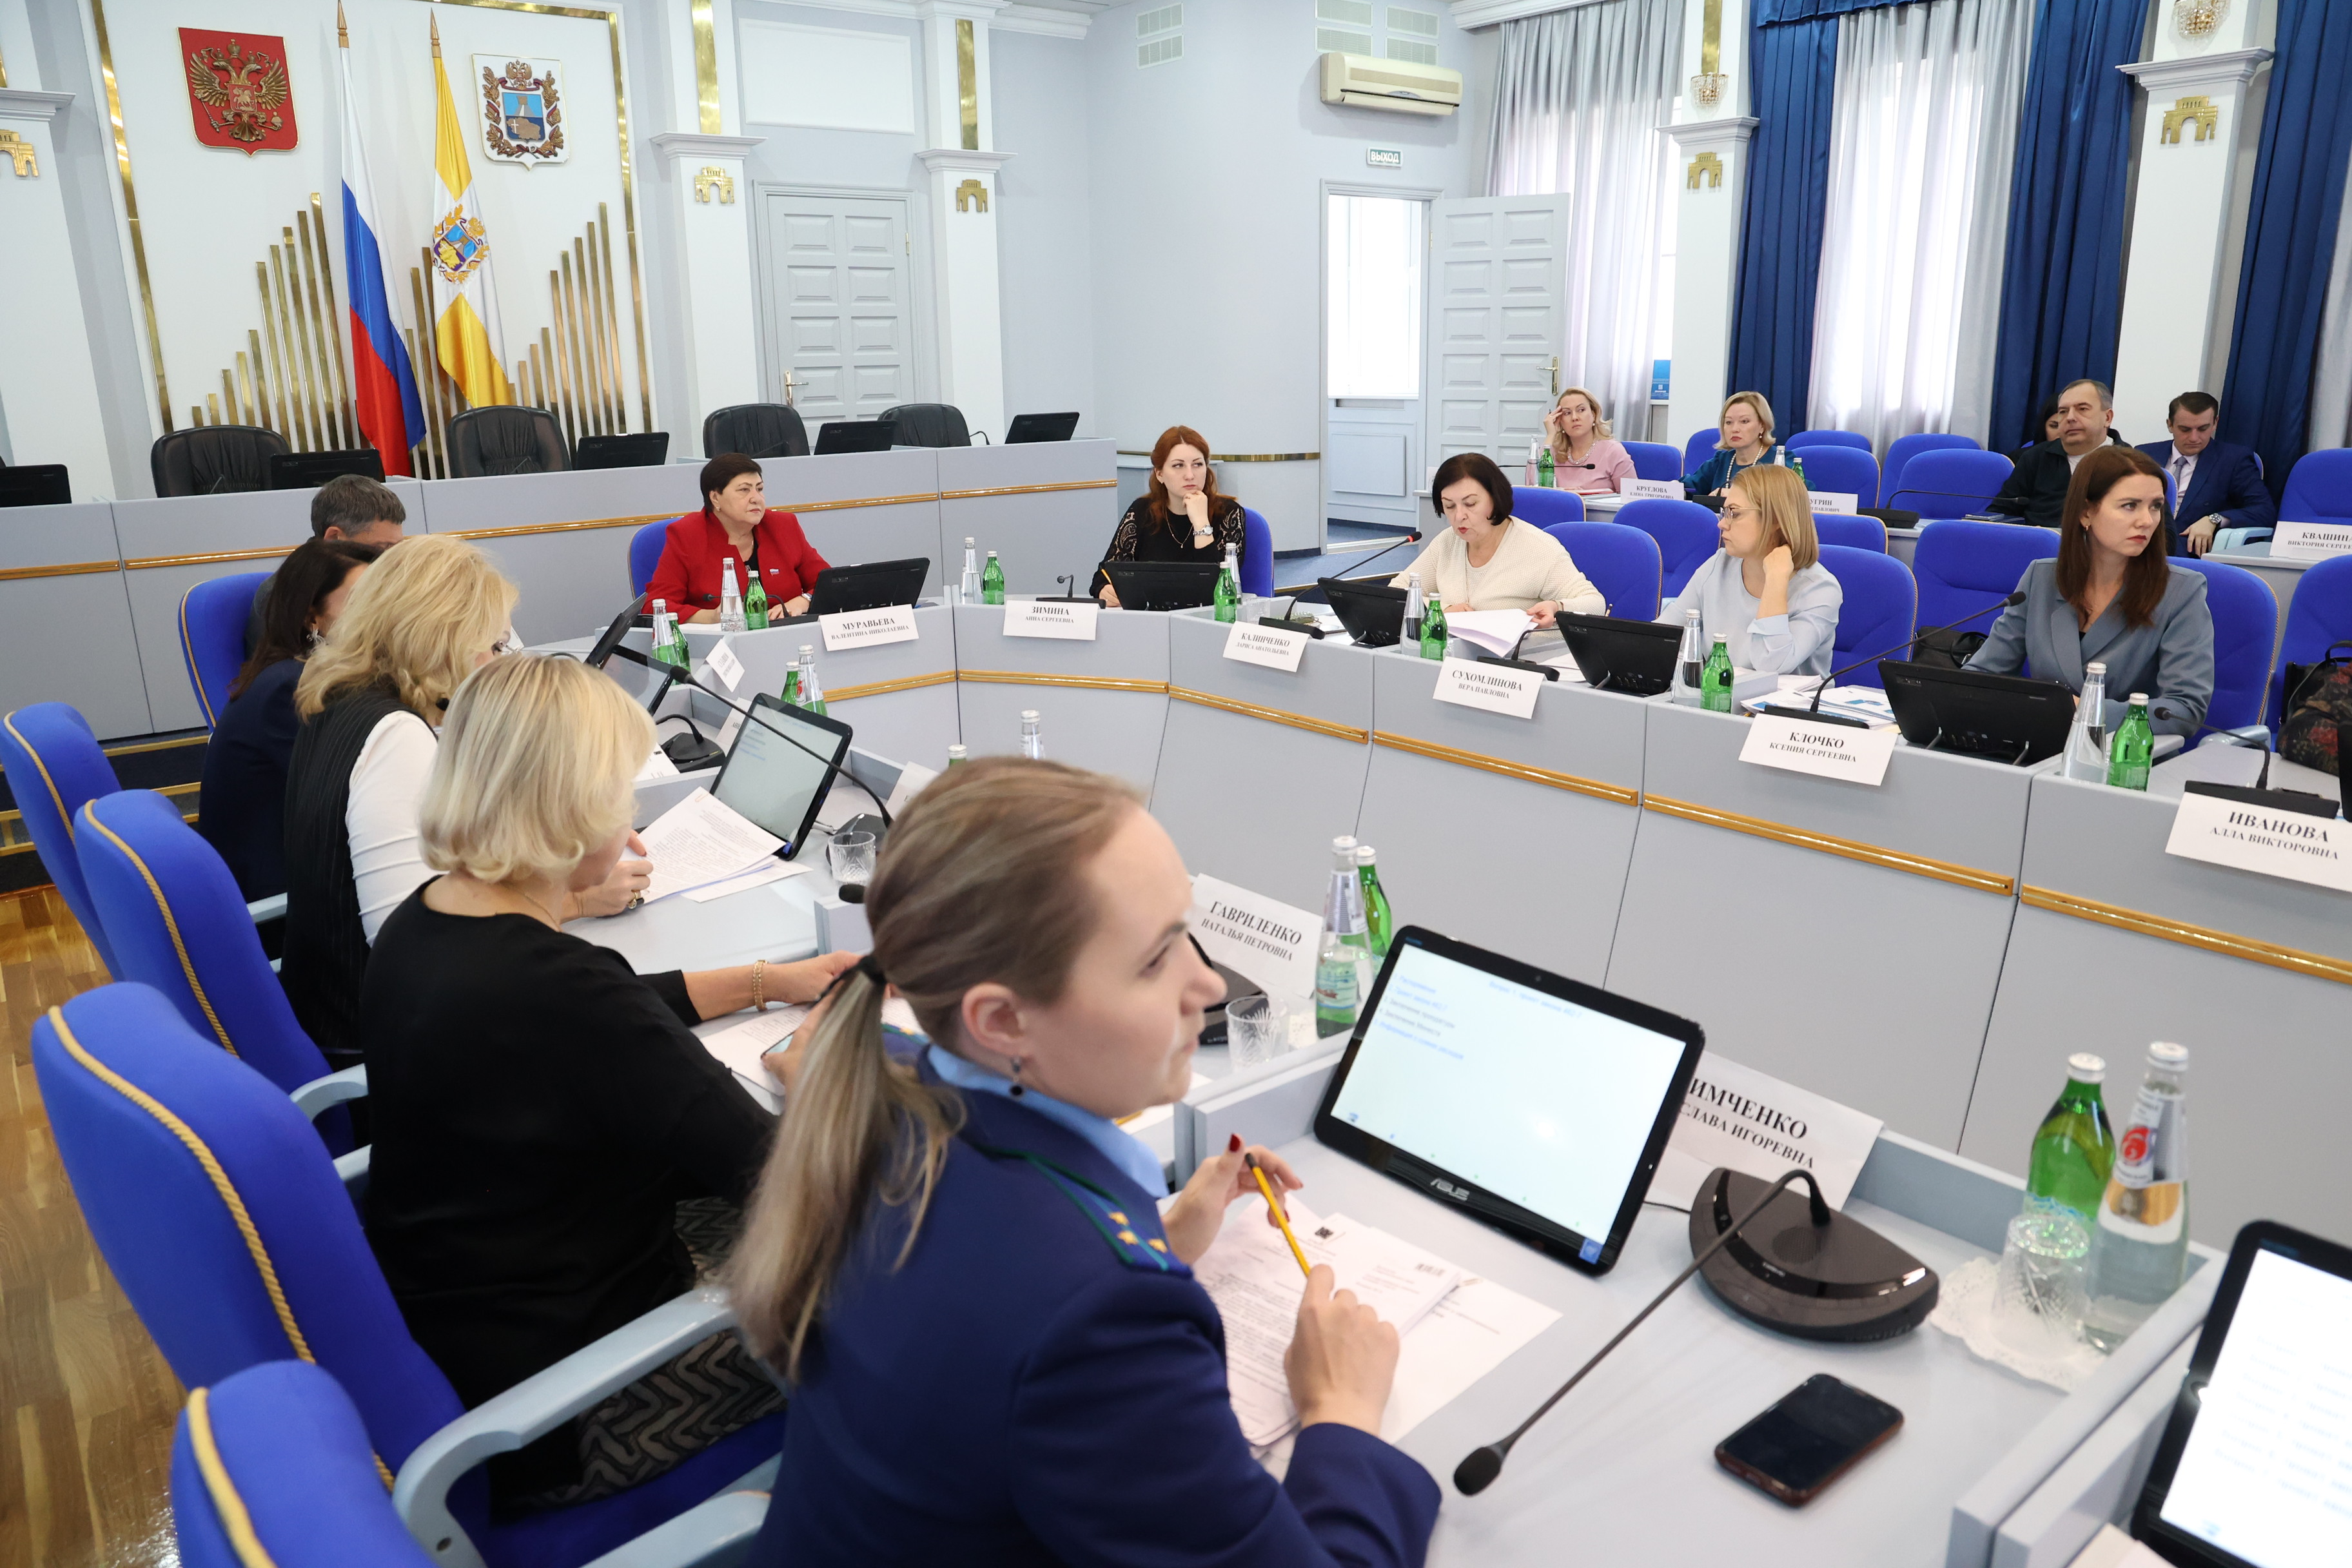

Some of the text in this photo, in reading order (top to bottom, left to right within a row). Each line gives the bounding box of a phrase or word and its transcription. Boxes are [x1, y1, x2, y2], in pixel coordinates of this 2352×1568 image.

[1371, 150, 1399, 163] ВЫХОД
[2288, 540, 2325, 548] ВИКТОРИЯ
[1032, 605, 1070, 615] ЗИМИНА
[831, 625, 909, 640] ВАЛЕНТИНА НИКОЛАЕВНА
[842, 618, 896, 631] МУРАВЬЕВА
[1241, 632, 1290, 647] КАЛИНЧЕНКО
[1235, 642, 1289, 656] ЛАРИСА АНАТОЛЬЕВНА
[1452, 670, 1522, 691] СУХОМЛИНОВА
[1458, 683, 1509, 699] ВЕРА ПАВЛОВНА
[1789, 732, 1845, 749] КЛОЧКО
[1769, 742, 1856, 762] КСЕНИЯ СЕРГЕЕВНА
[2228, 811, 2329, 843] ИВАНОВА
[2210, 827, 2338, 860] АЛЛА ВИКТОРОВНА
[1210, 901, 1302, 946] ГАВРИЛЕНКО
[1201, 918, 1293, 961] НАТАЛЬЯ ПЕТРОВНА
[1689, 1077, 1808, 1139] ИМЧЕНКО
[1680, 1102, 1814, 1169] СЛАВА ИГОРЕВНА
[1430, 1178, 1470, 1201] ASUS
